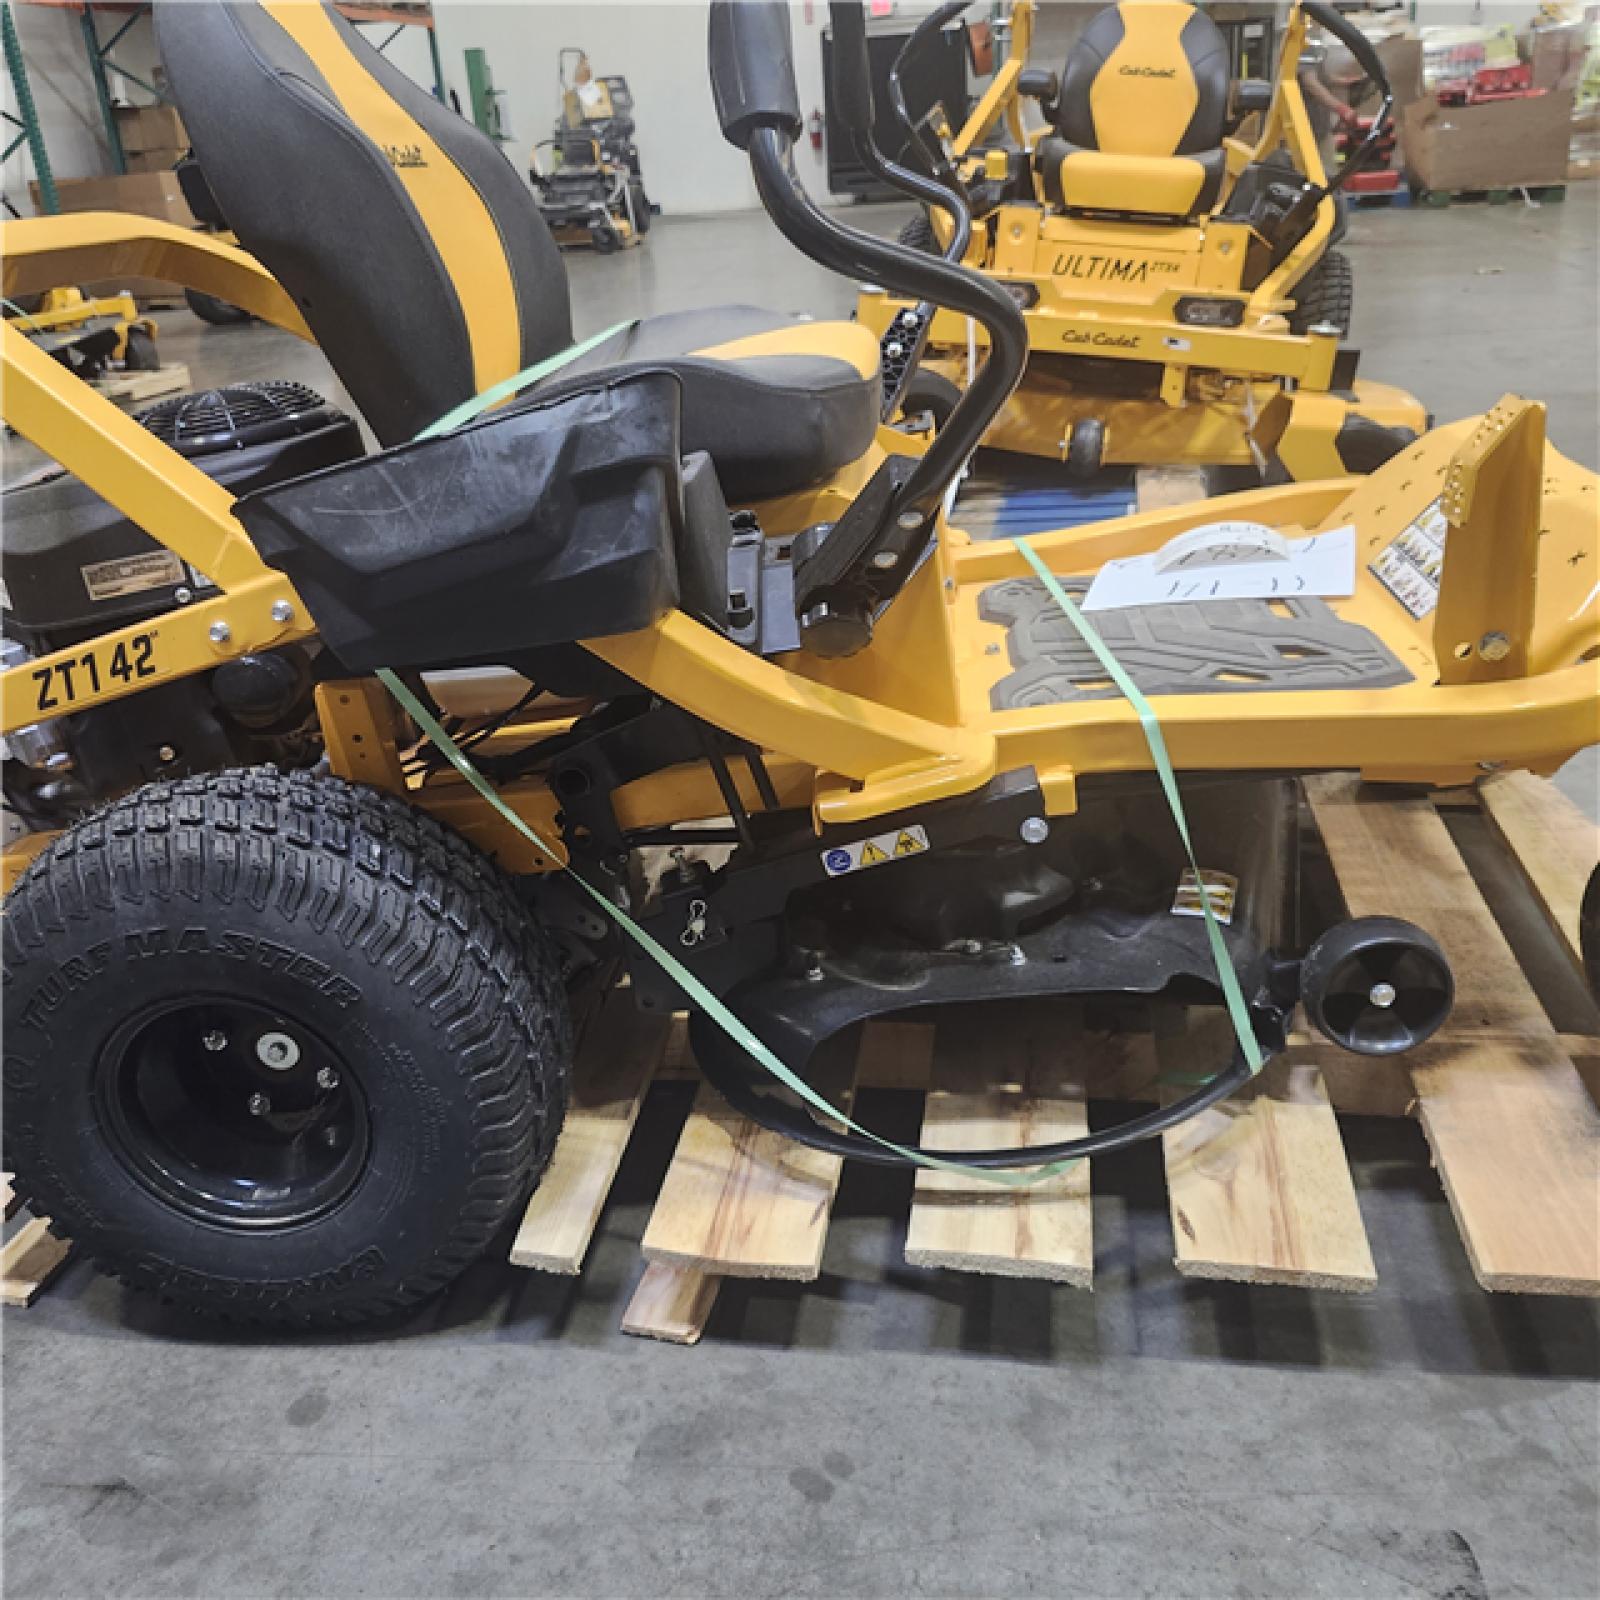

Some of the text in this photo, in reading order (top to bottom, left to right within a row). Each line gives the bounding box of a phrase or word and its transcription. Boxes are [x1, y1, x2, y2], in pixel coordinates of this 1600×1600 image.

[1051, 253, 1148, 283] ULTIMA
[1061, 329, 1141, 348] Cub Cadet
[32, 652, 100, 711] ZT1
[19, 925, 363, 1032] TURF MASTER
